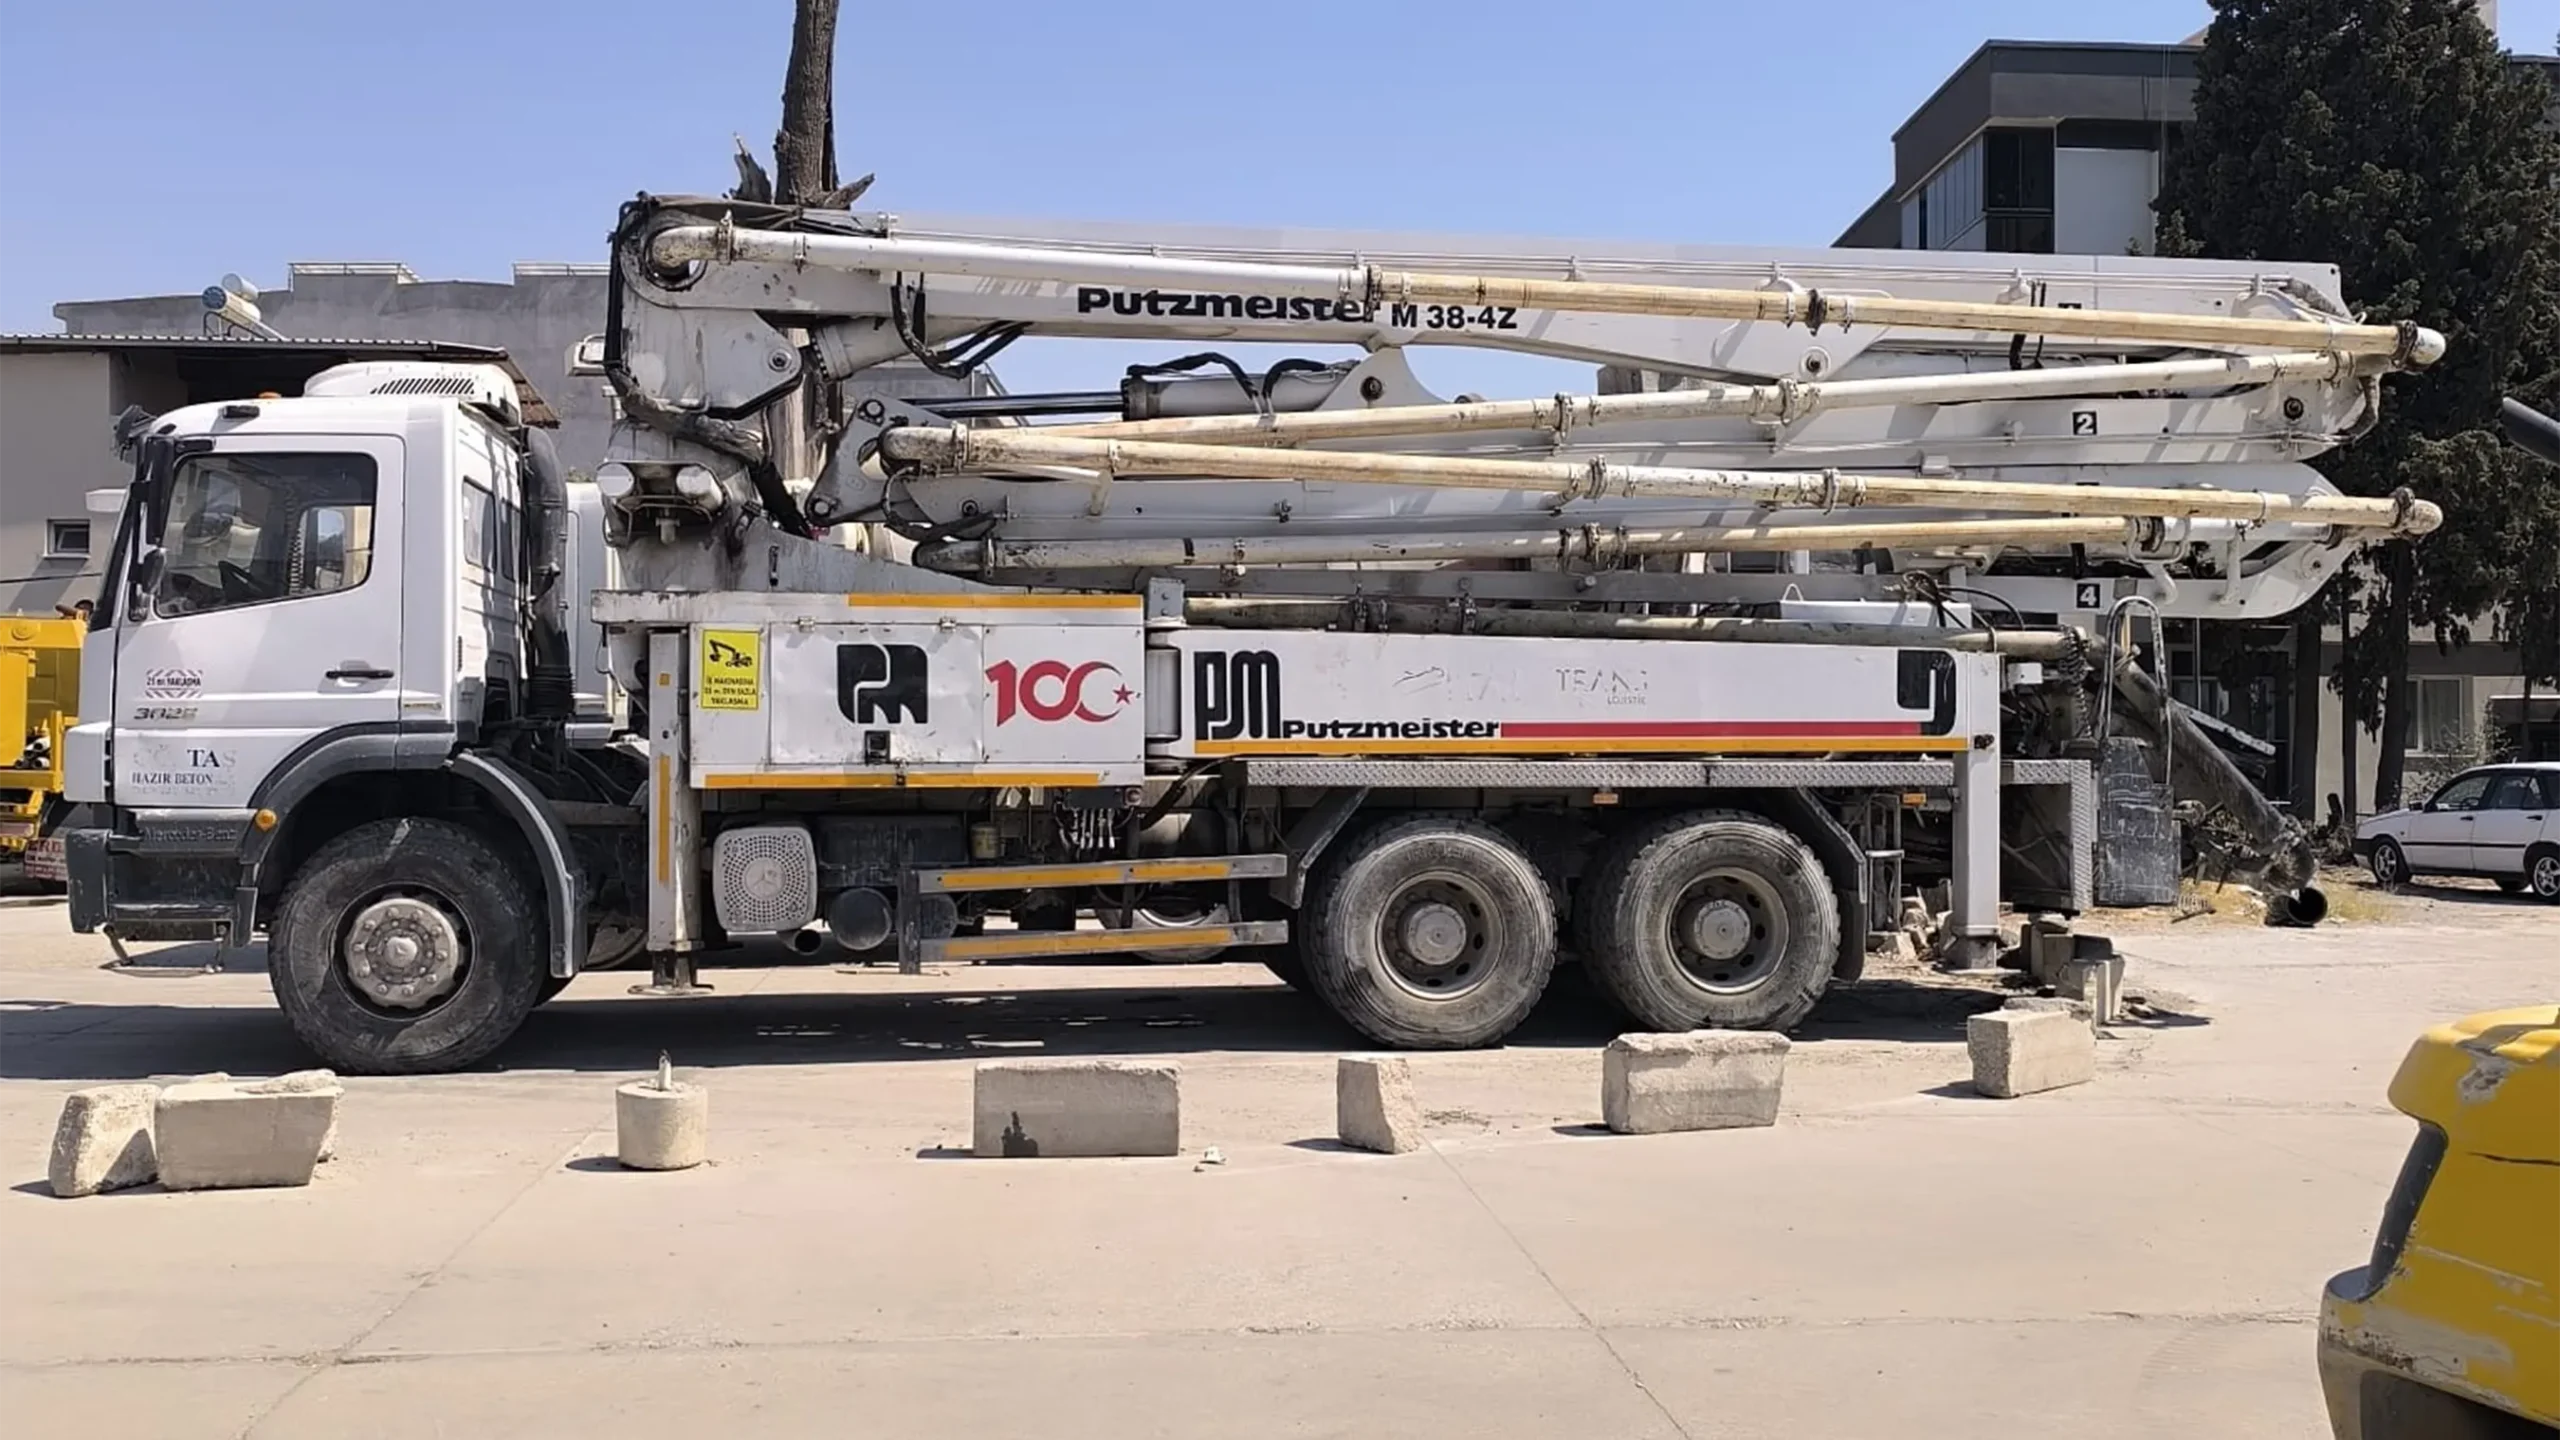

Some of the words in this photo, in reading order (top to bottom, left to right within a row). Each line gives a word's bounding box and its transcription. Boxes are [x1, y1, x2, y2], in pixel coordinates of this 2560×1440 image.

[1077, 287, 1380, 323] Putzmeister
[1391, 303, 1418, 328] M
[1426, 305, 1517, 329] 38-4Z
[2076, 413, 2094, 434] 2
[2080, 585, 2097, 606] 4
[1282, 717, 1499, 739] Putzmeister
